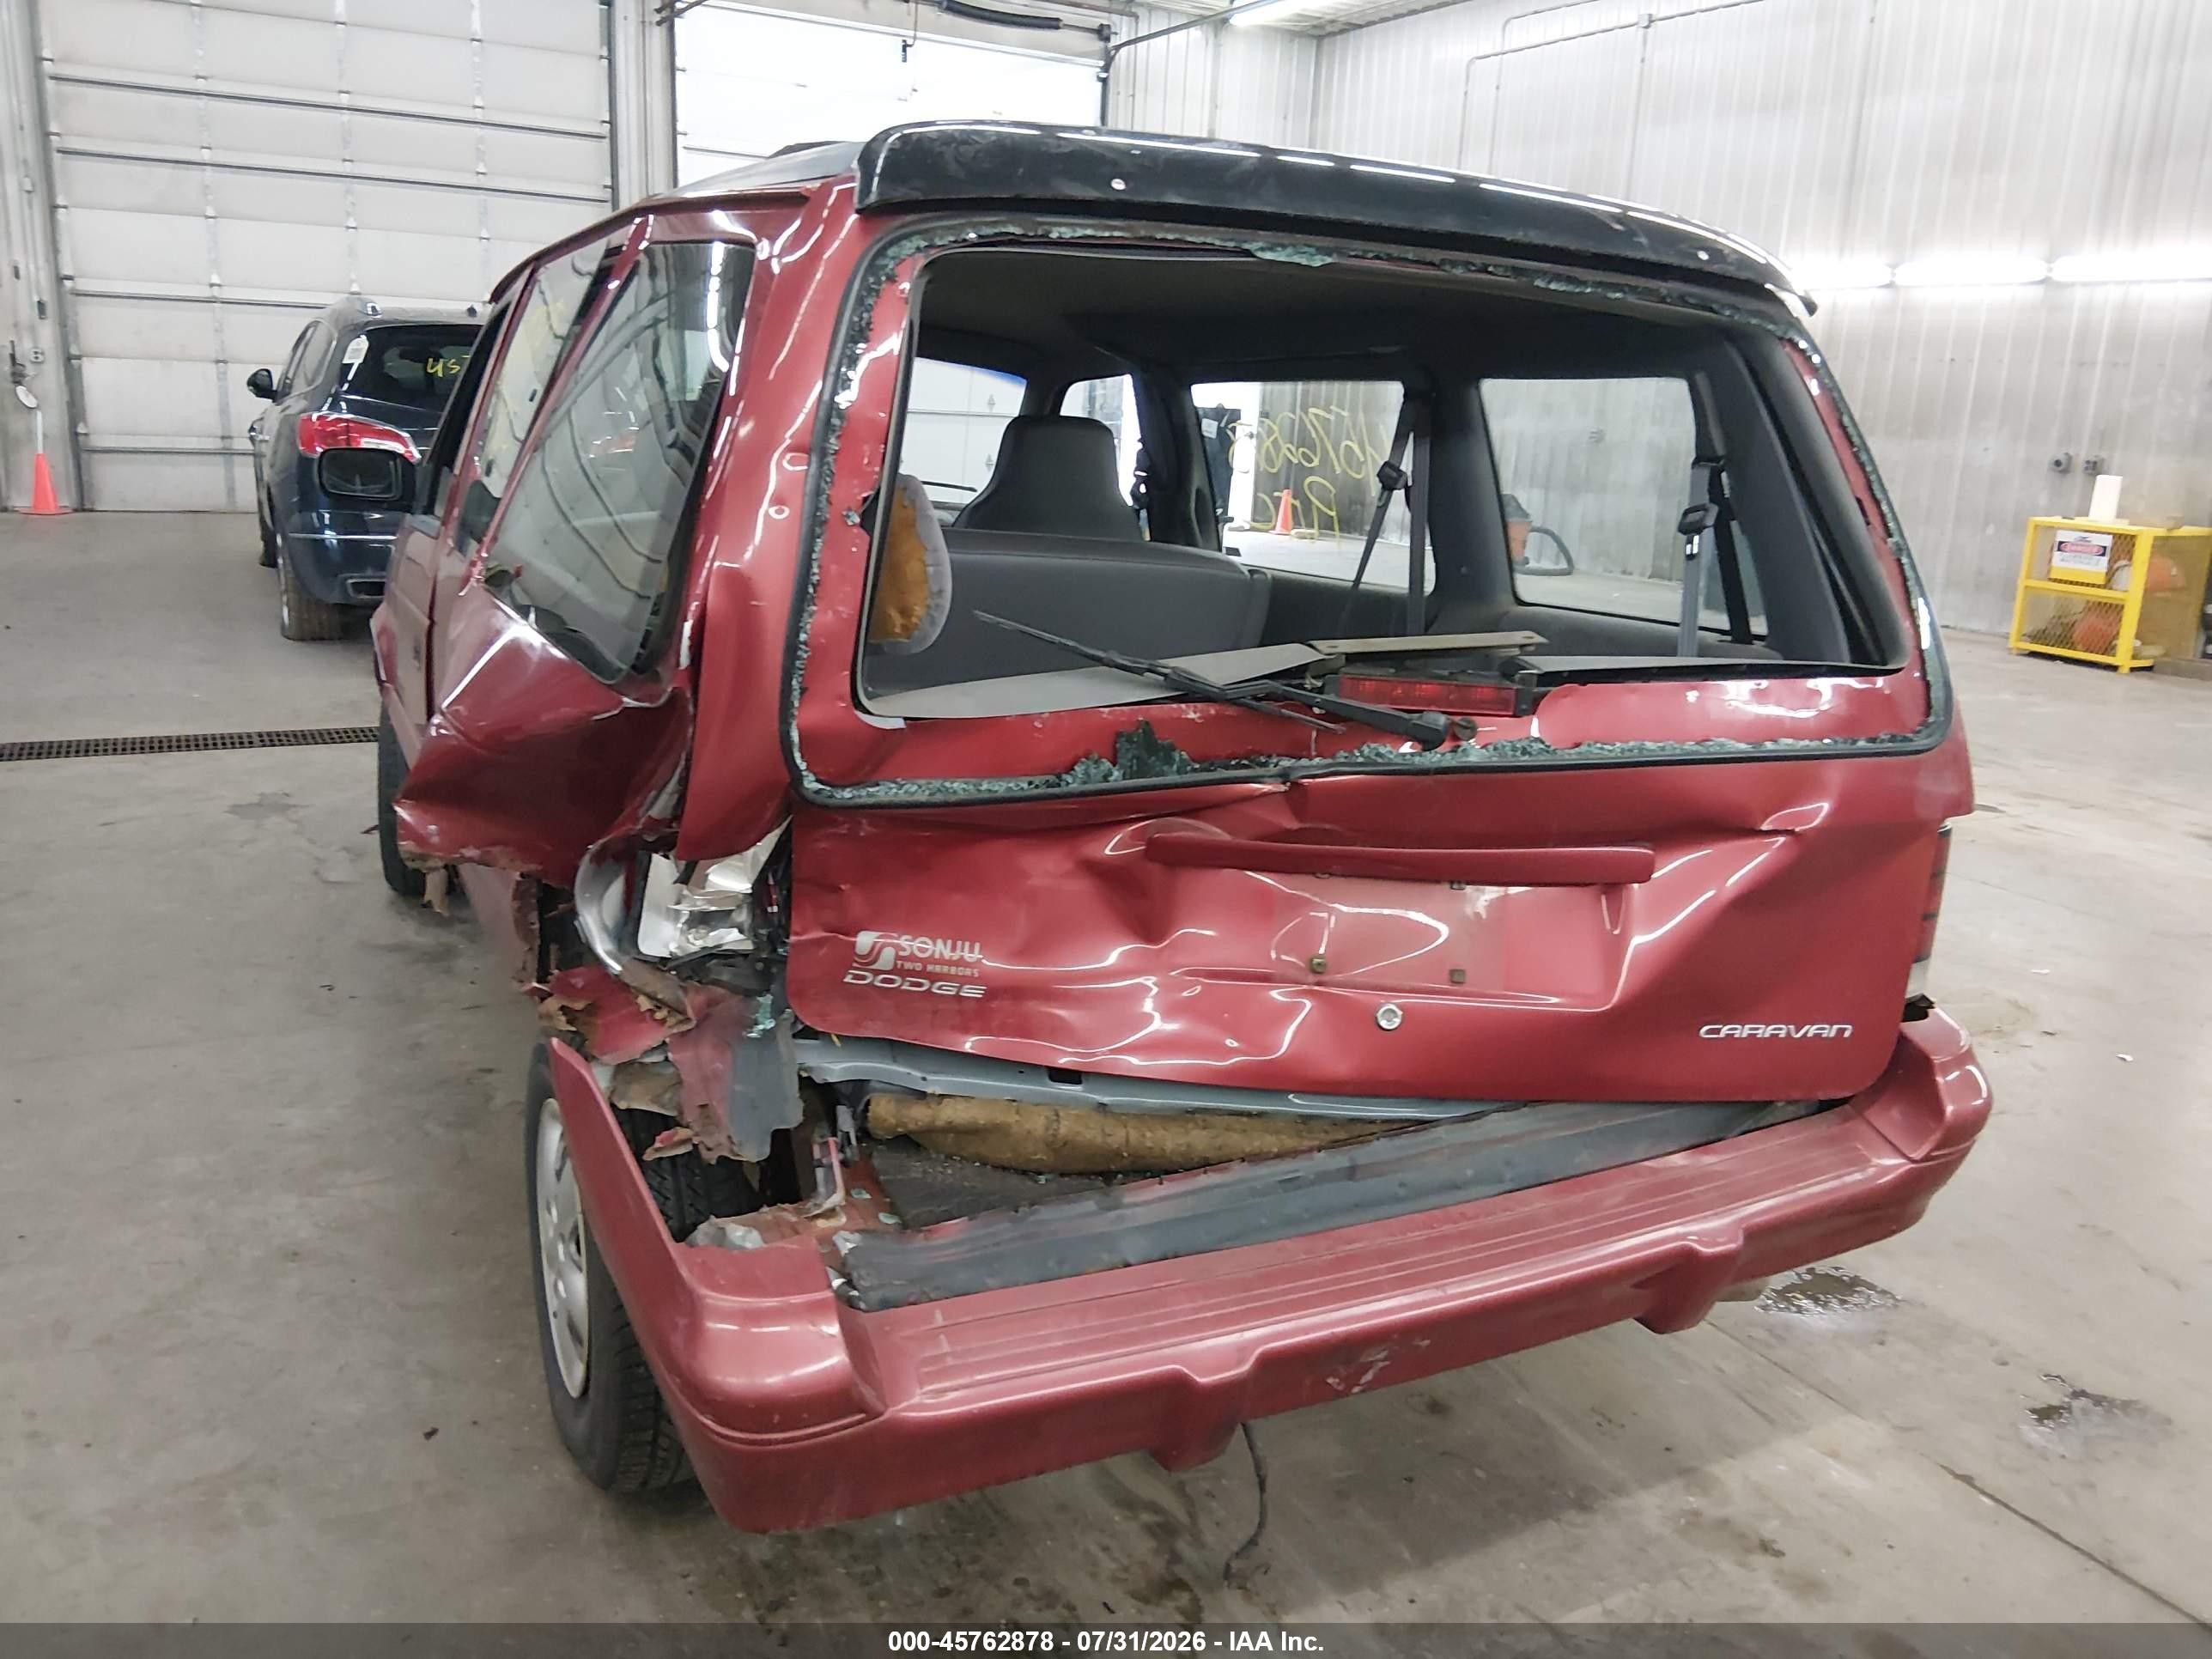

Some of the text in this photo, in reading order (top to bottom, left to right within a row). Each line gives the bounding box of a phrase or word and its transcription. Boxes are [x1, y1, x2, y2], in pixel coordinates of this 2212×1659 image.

[897, 934, 981, 963] SONJU
[896, 960, 922, 971] TWO
[842, 969, 987, 998] DODGE
[1698, 1024, 1853, 1038] CARAVAN
